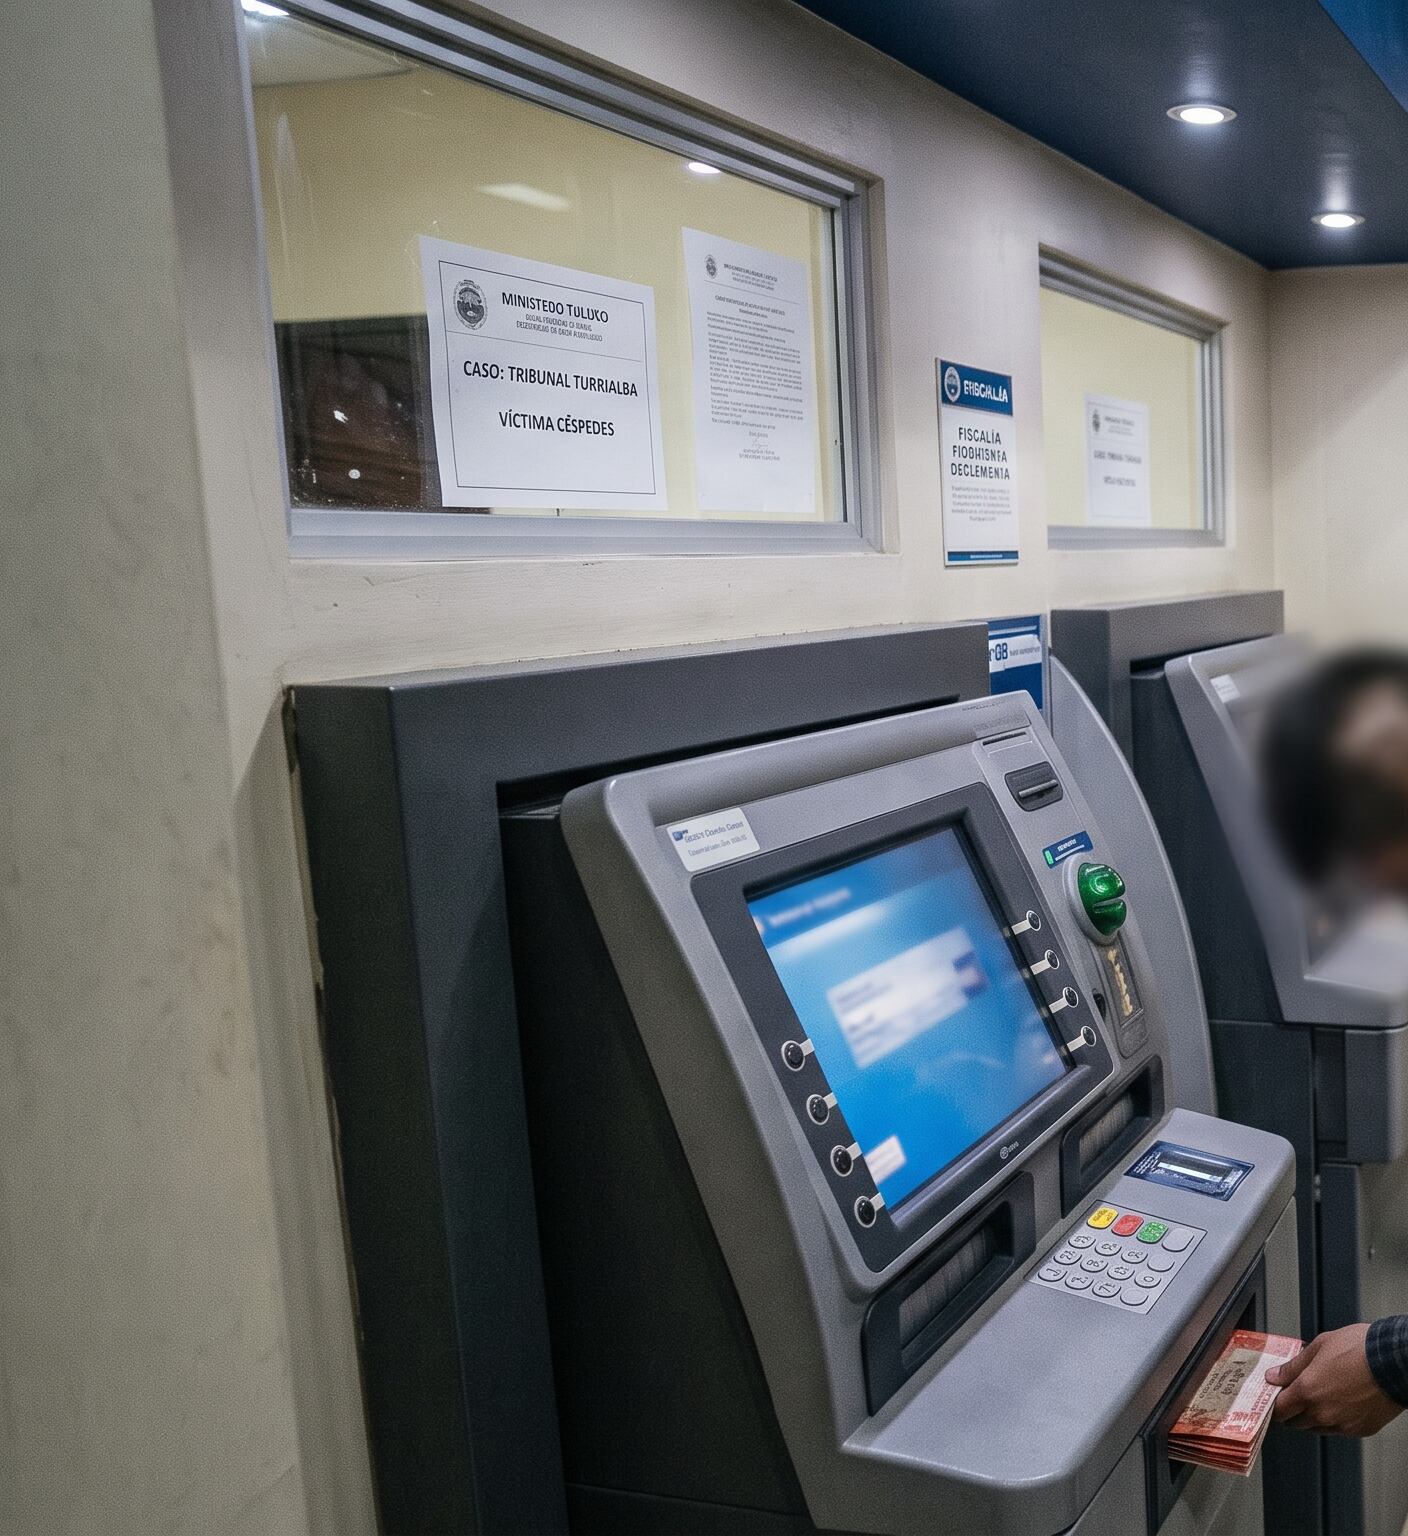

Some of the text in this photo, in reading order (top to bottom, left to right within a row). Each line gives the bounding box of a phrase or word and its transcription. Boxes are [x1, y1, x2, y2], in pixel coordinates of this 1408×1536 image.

[502, 292, 564, 315] MINISTEDO
[463, 360, 638, 397] CASO: TRIBUNAL TURRIALBA
[499, 409, 555, 431] VÍCTIMA
[958, 427, 1001, 445] FISCALÍA
